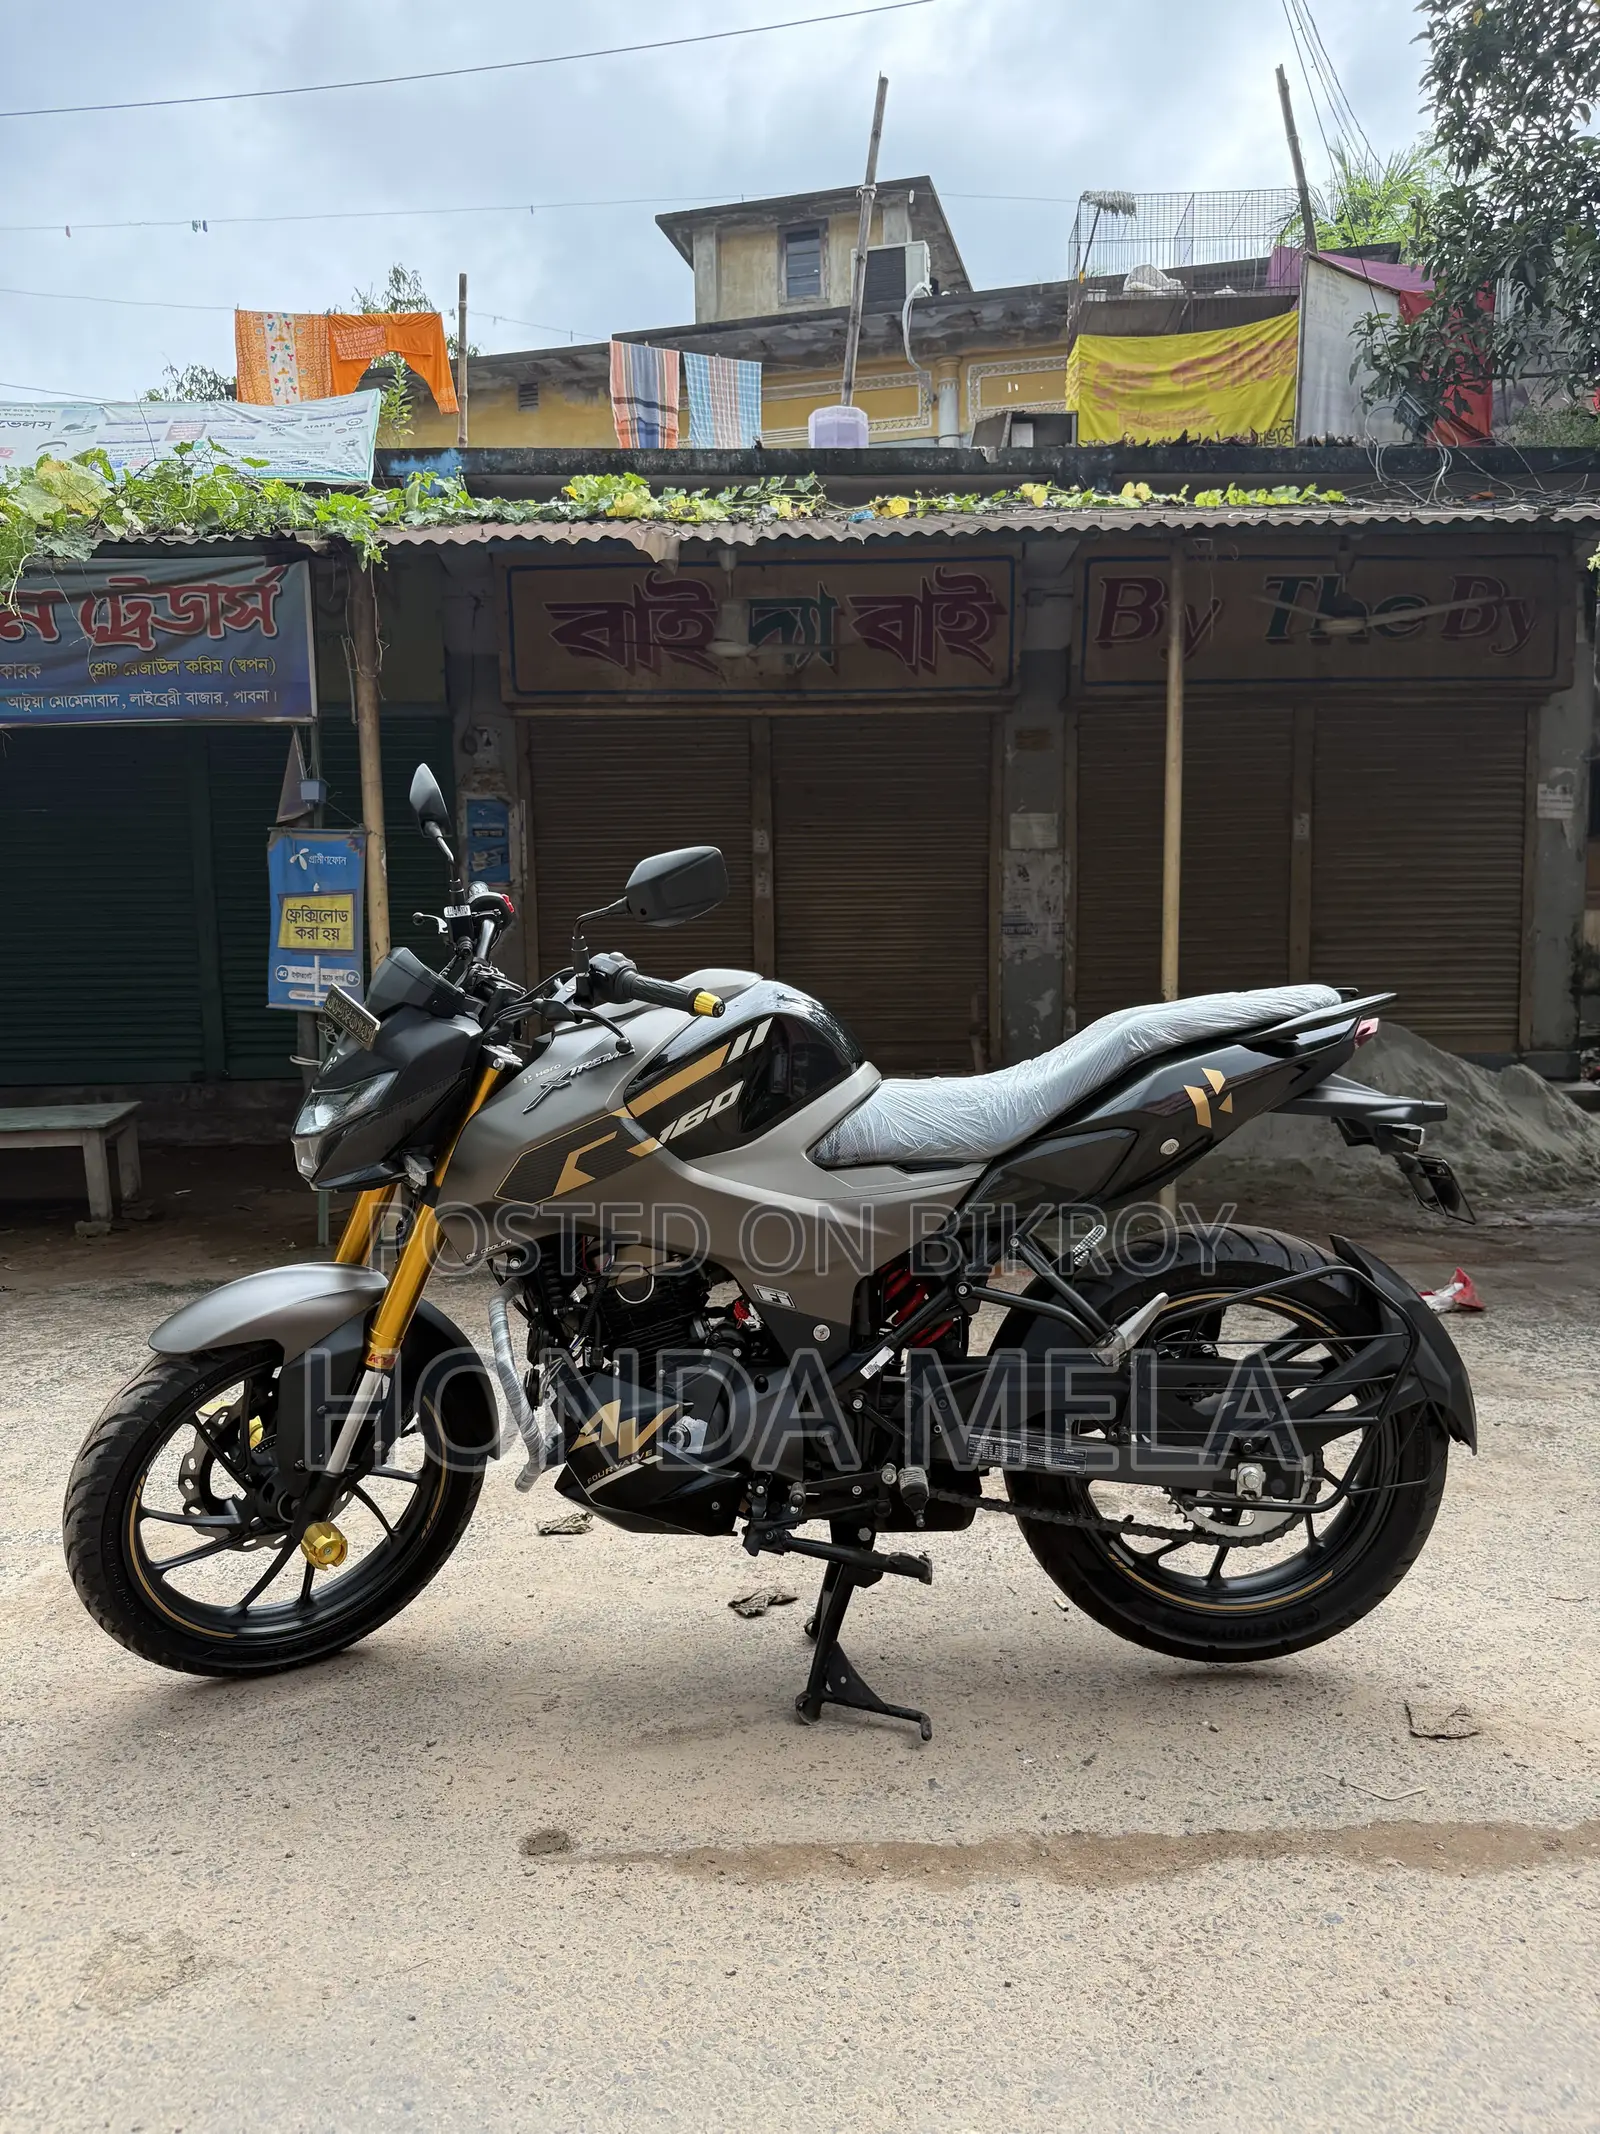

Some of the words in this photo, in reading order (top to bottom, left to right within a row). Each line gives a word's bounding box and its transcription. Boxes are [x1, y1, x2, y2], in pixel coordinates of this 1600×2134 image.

[79, 565, 289, 651] ট্রেডার্স
[1094, 575, 1222, 662] By
[1263, 573, 1430, 645] The
[1440, 573, 1539, 657] By
[542, 568, 727, 685] বাই
[845, 565, 1008, 676] বাই
[124, 656, 180, 676] রেজাউল
[184, 654, 223, 675] করিম
[229, 656, 276, 678] (স্বপন)
[6, 692, 45, 712] আটুয়া
[129, 688, 181, 708] লাইব্রেরী
[308, 852, 347, 866] গ্রামীণফোন
[285, 904, 349, 924] ফ্লেক্সিলোড
[295, 926, 320, 941] করা
[322, 927, 341, 942] হয়
[522, 1045, 636, 1114] XTREM
[535, 1063, 562, 1079] Hero
[659, 1080, 745, 1144] 160
[480, 1239, 512, 1254] COOLER
